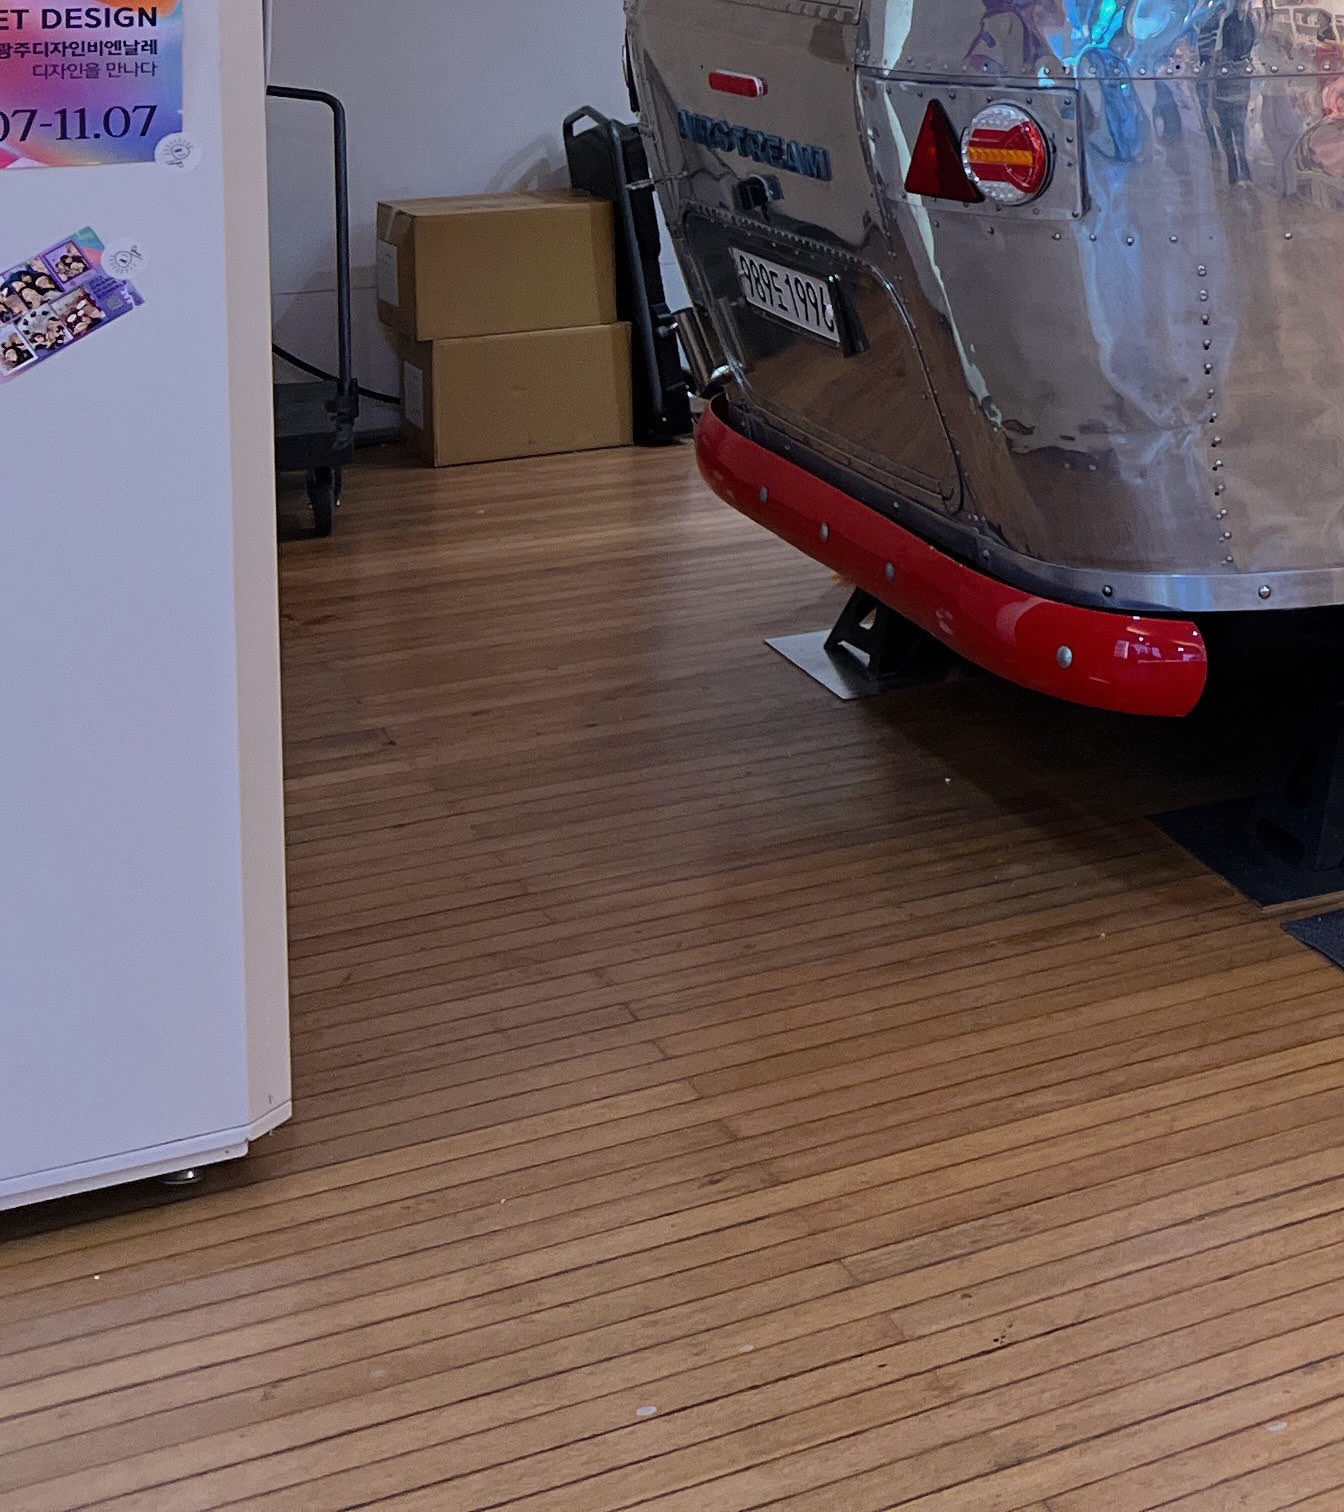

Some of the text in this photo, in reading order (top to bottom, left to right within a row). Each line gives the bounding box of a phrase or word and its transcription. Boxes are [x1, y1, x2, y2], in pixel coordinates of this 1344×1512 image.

[42, 7, 157, 29] DESIGN
[33, 61, 158, 80] 디자인을 만나다
